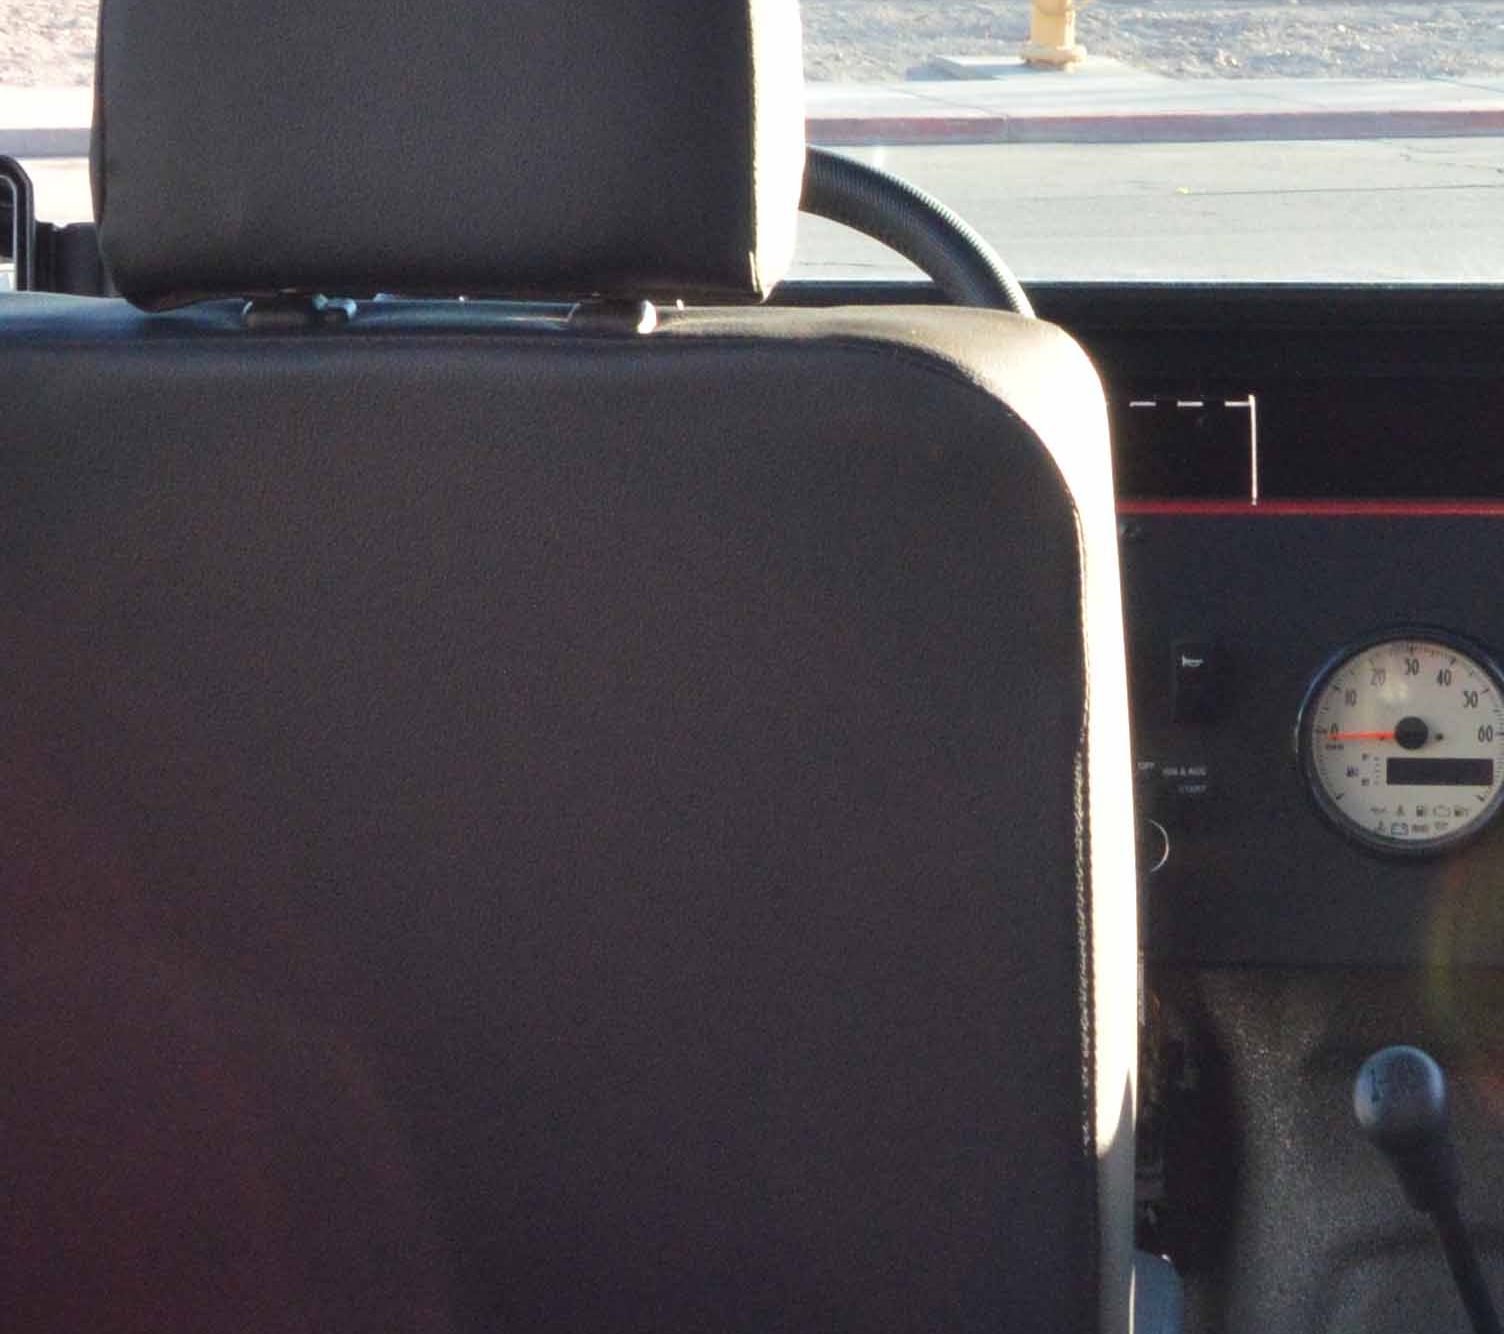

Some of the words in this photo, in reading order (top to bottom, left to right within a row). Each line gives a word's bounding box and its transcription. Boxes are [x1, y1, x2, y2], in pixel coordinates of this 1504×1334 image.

[1436, 669, 1452, 687] 40
[1344, 689, 1358, 708] 10
[1463, 690, 1479, 708] 50
[1477, 724, 1494, 743] 60
